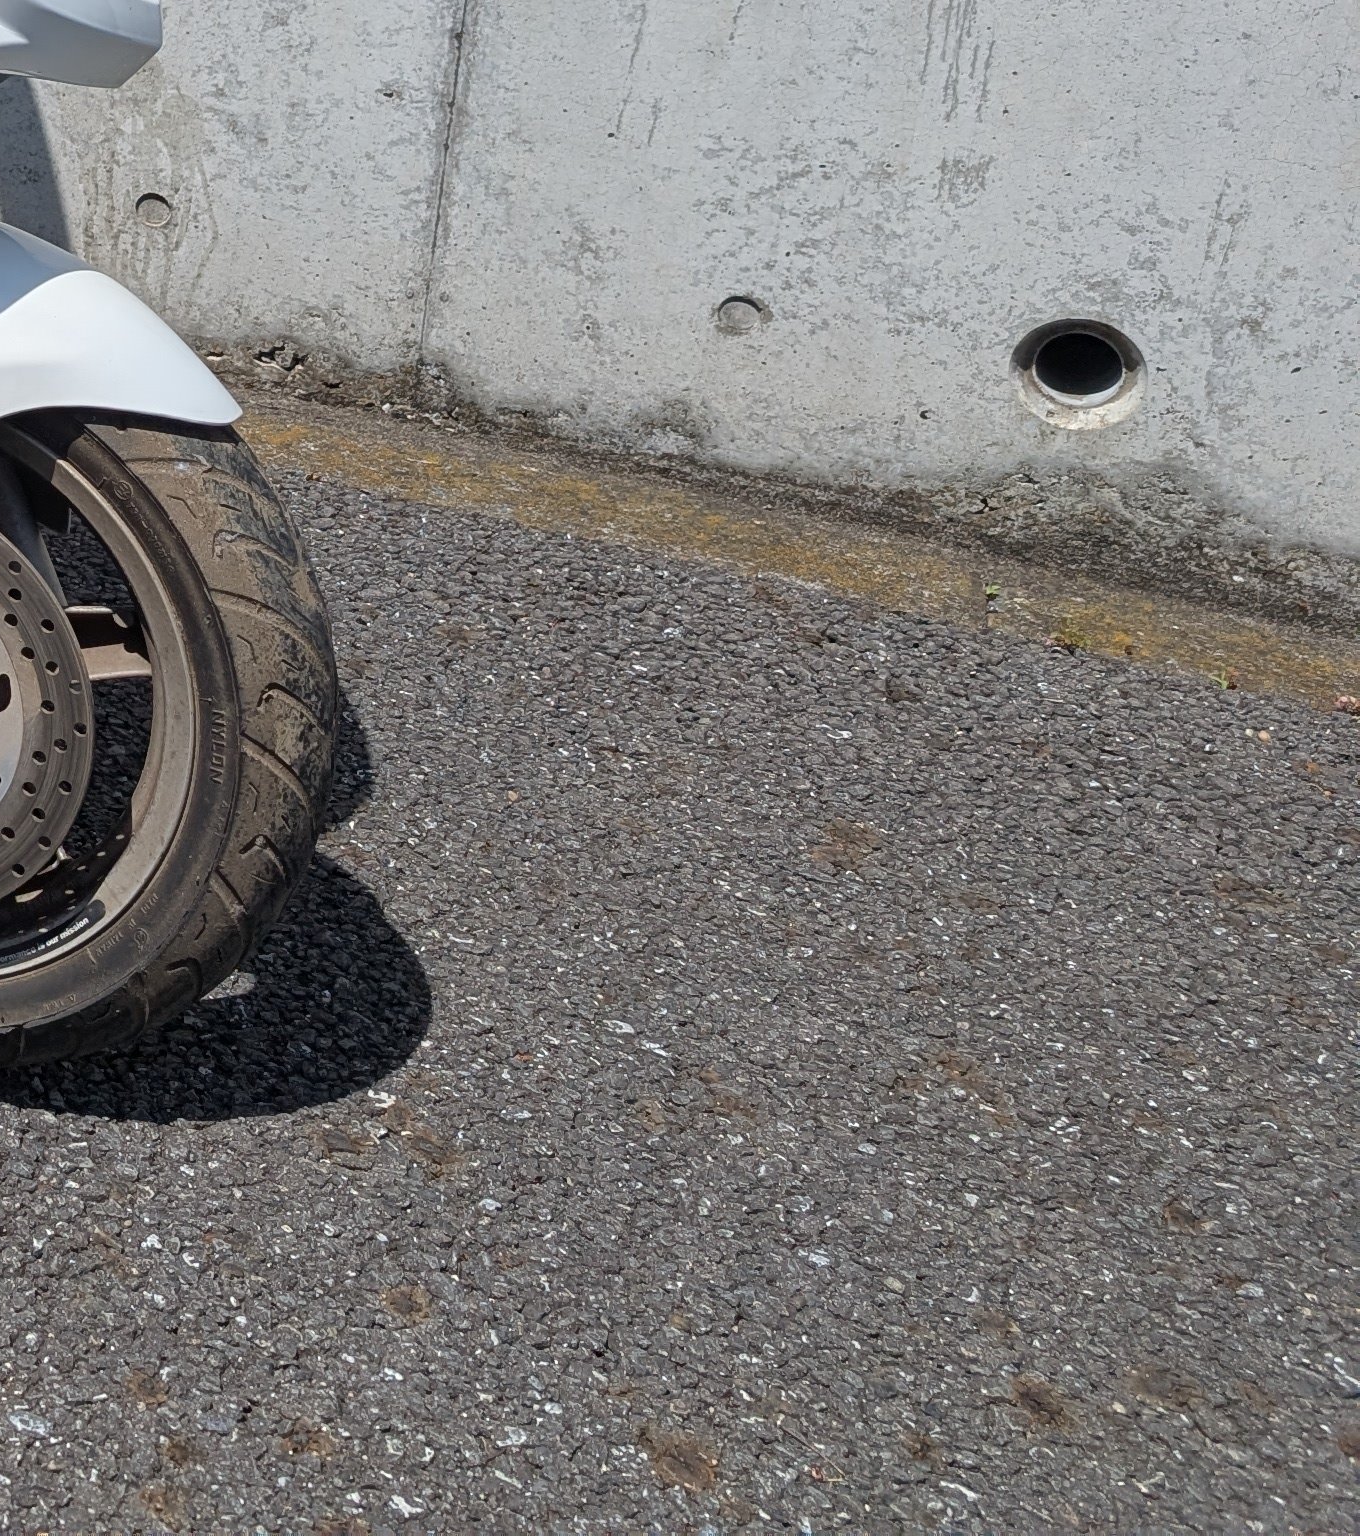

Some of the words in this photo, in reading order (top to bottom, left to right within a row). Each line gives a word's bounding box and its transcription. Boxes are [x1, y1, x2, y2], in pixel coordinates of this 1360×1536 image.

[208, 709, 227, 785] NYLON
[46, 935, 60, 946] our
[60, 917, 90, 939] mission
